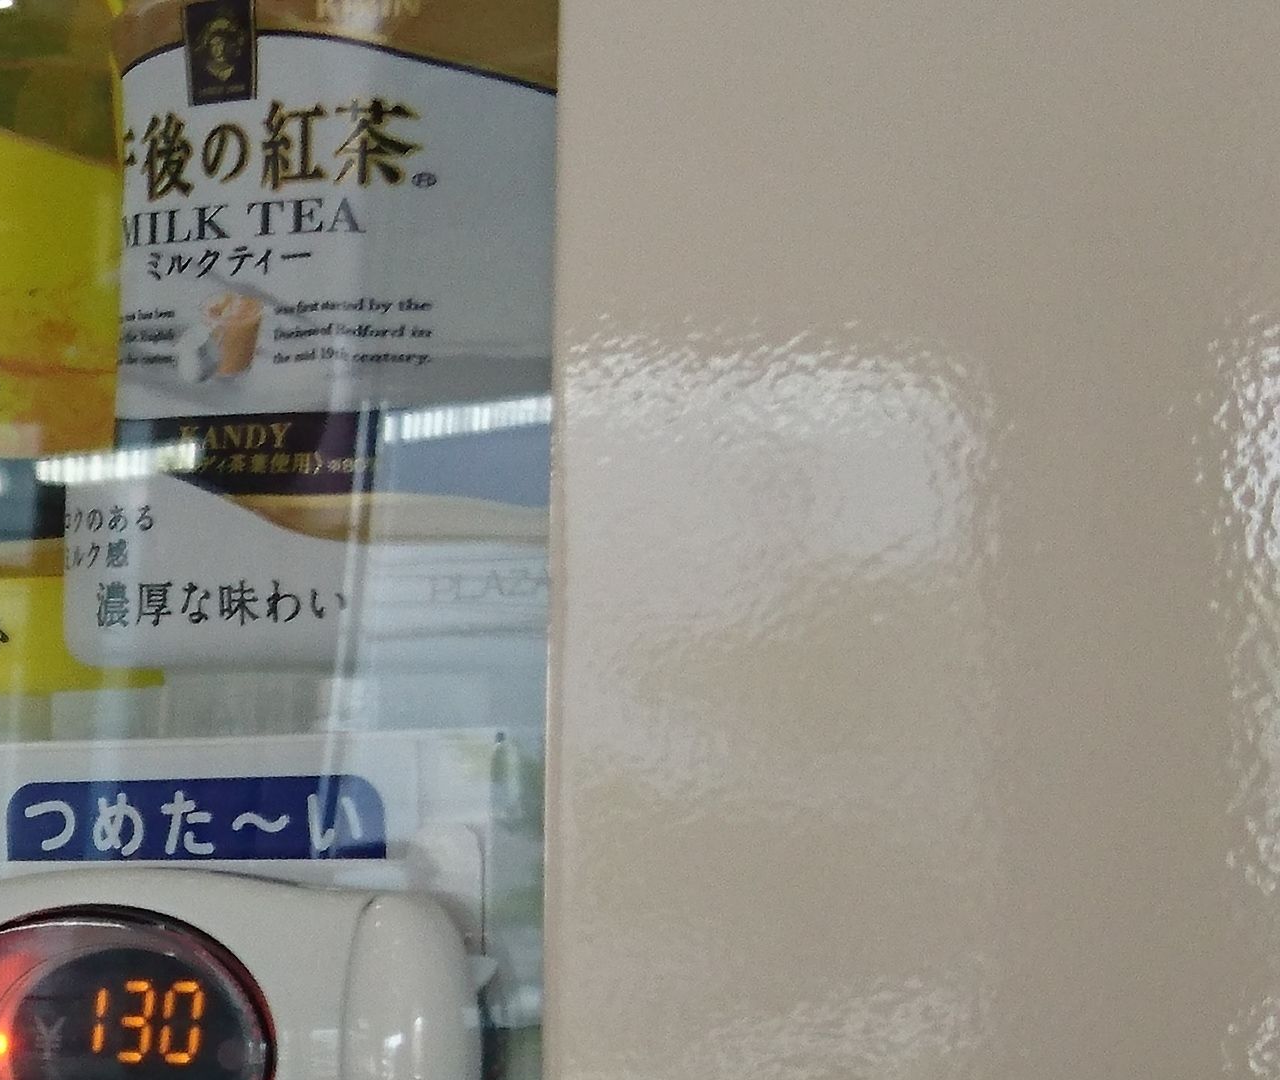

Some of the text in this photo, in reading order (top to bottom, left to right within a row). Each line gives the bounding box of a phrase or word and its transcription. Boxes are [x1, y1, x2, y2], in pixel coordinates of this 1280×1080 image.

[246, 197, 366, 236] TEA
[146, 247, 311, 279] ミルクティー
[96, 579, 347, 629] 濃厚な味わい
[26, 788, 364, 858] つめた〜い
[89, 979, 206, 1066] 130
